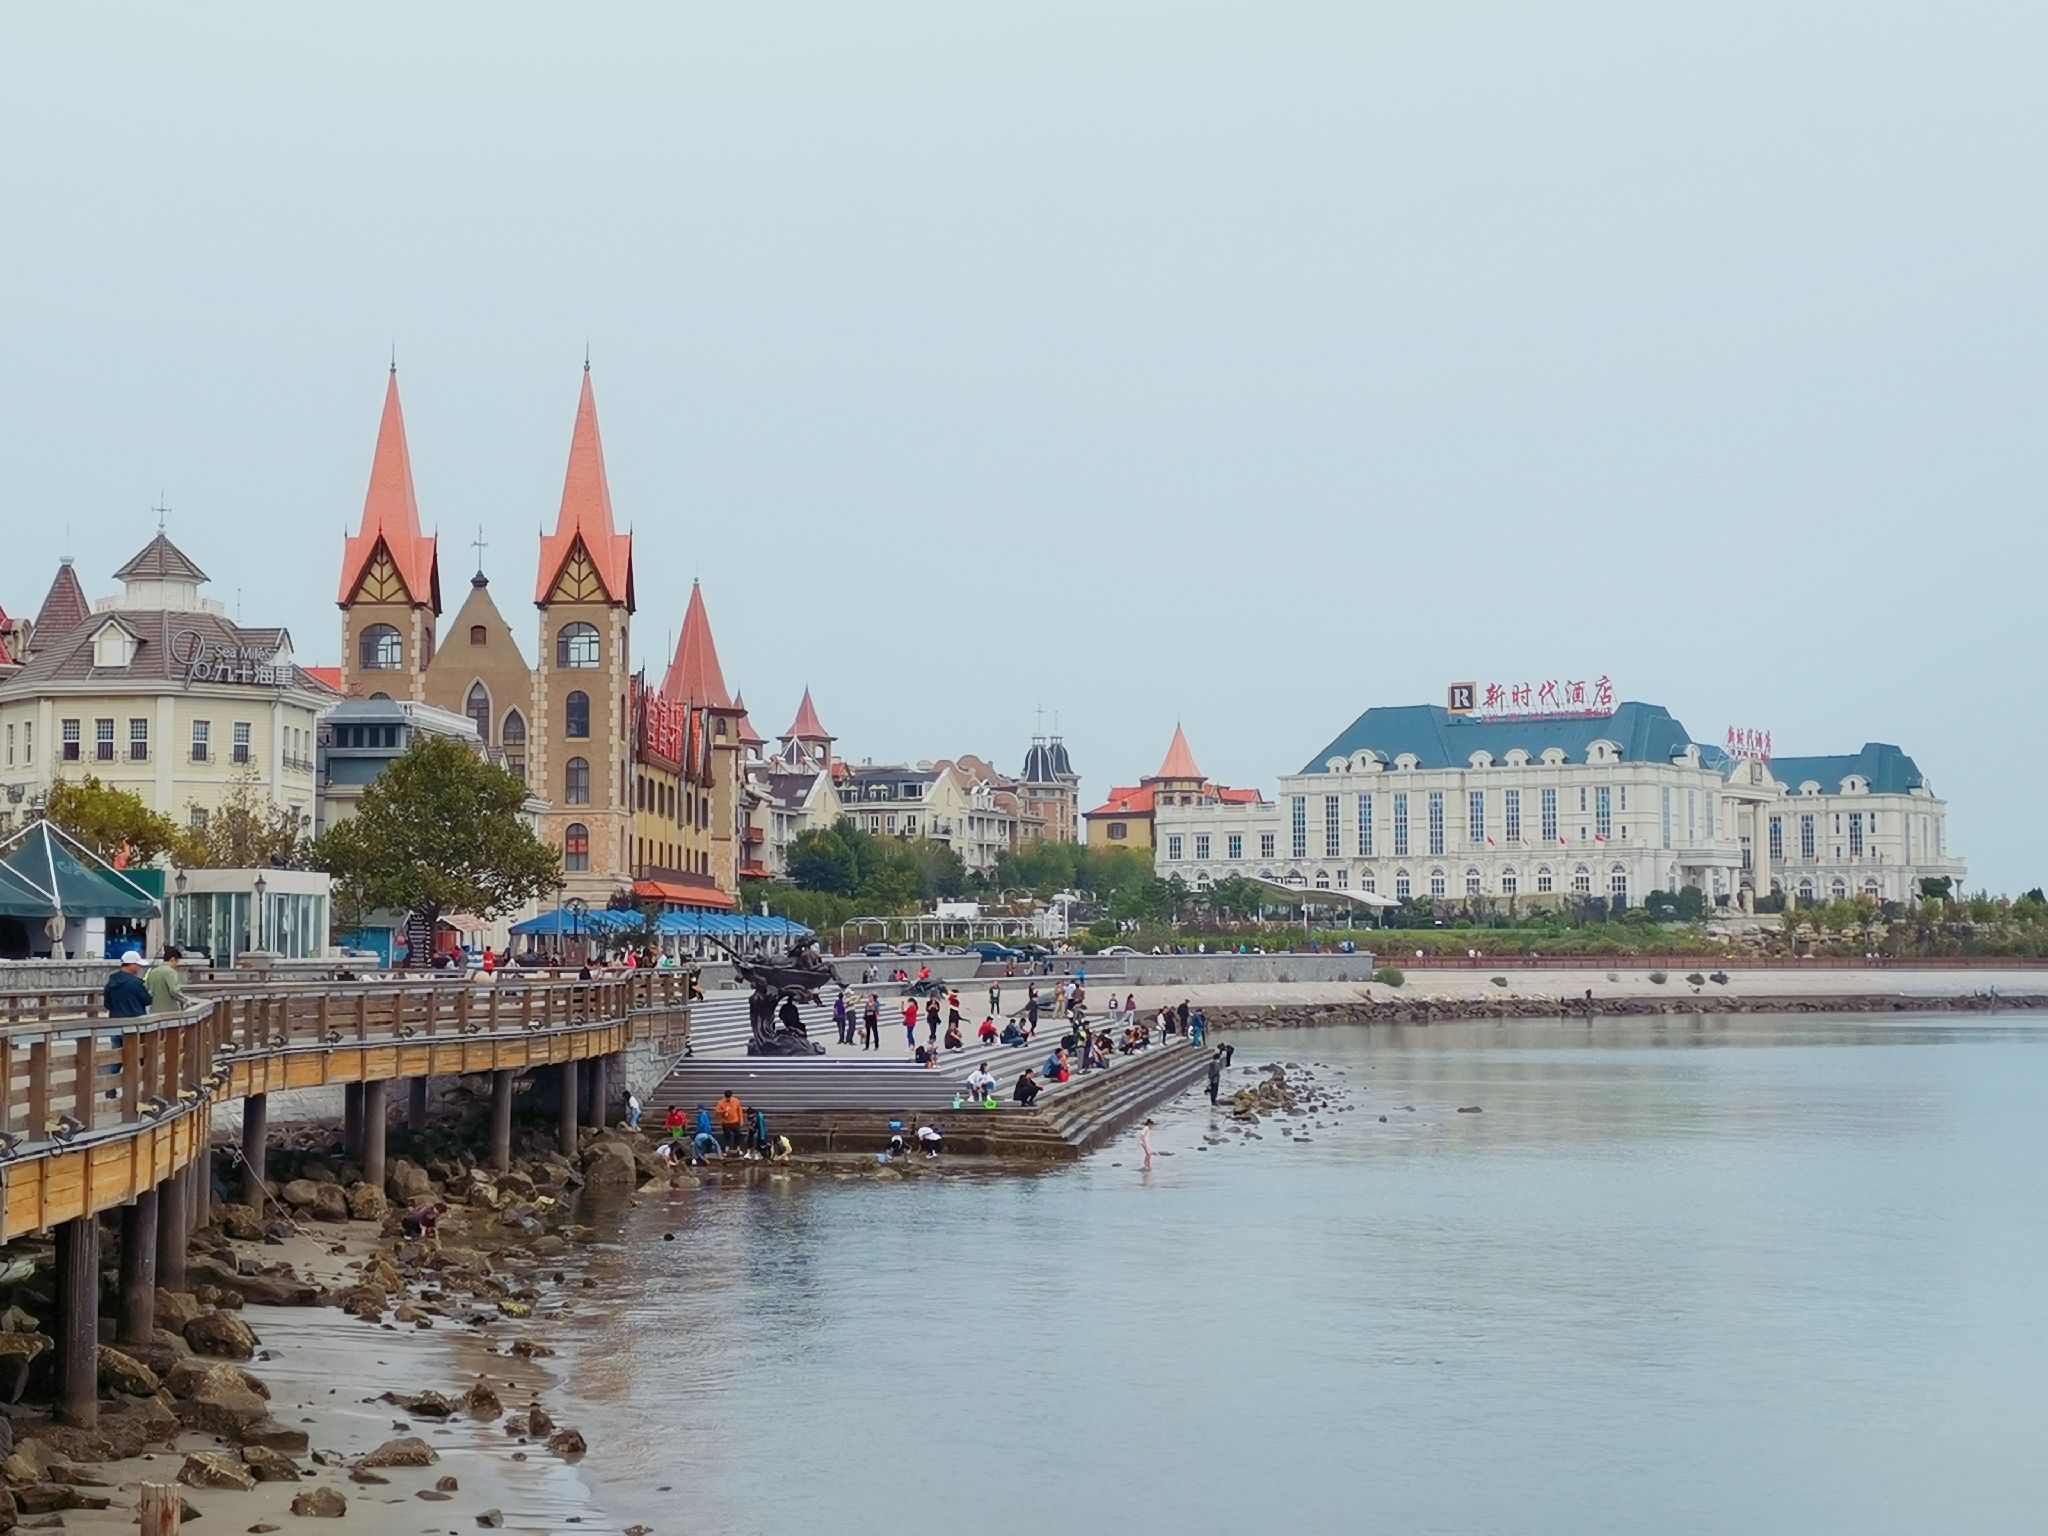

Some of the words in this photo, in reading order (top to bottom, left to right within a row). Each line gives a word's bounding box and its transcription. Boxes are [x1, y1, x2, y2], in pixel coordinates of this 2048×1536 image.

[214, 645, 237, 658] Sea
[214, 662, 294, 685] 九十海里
[1453, 688, 1471, 708] R
[1482, 675, 1613, 712] 新时代酒店
